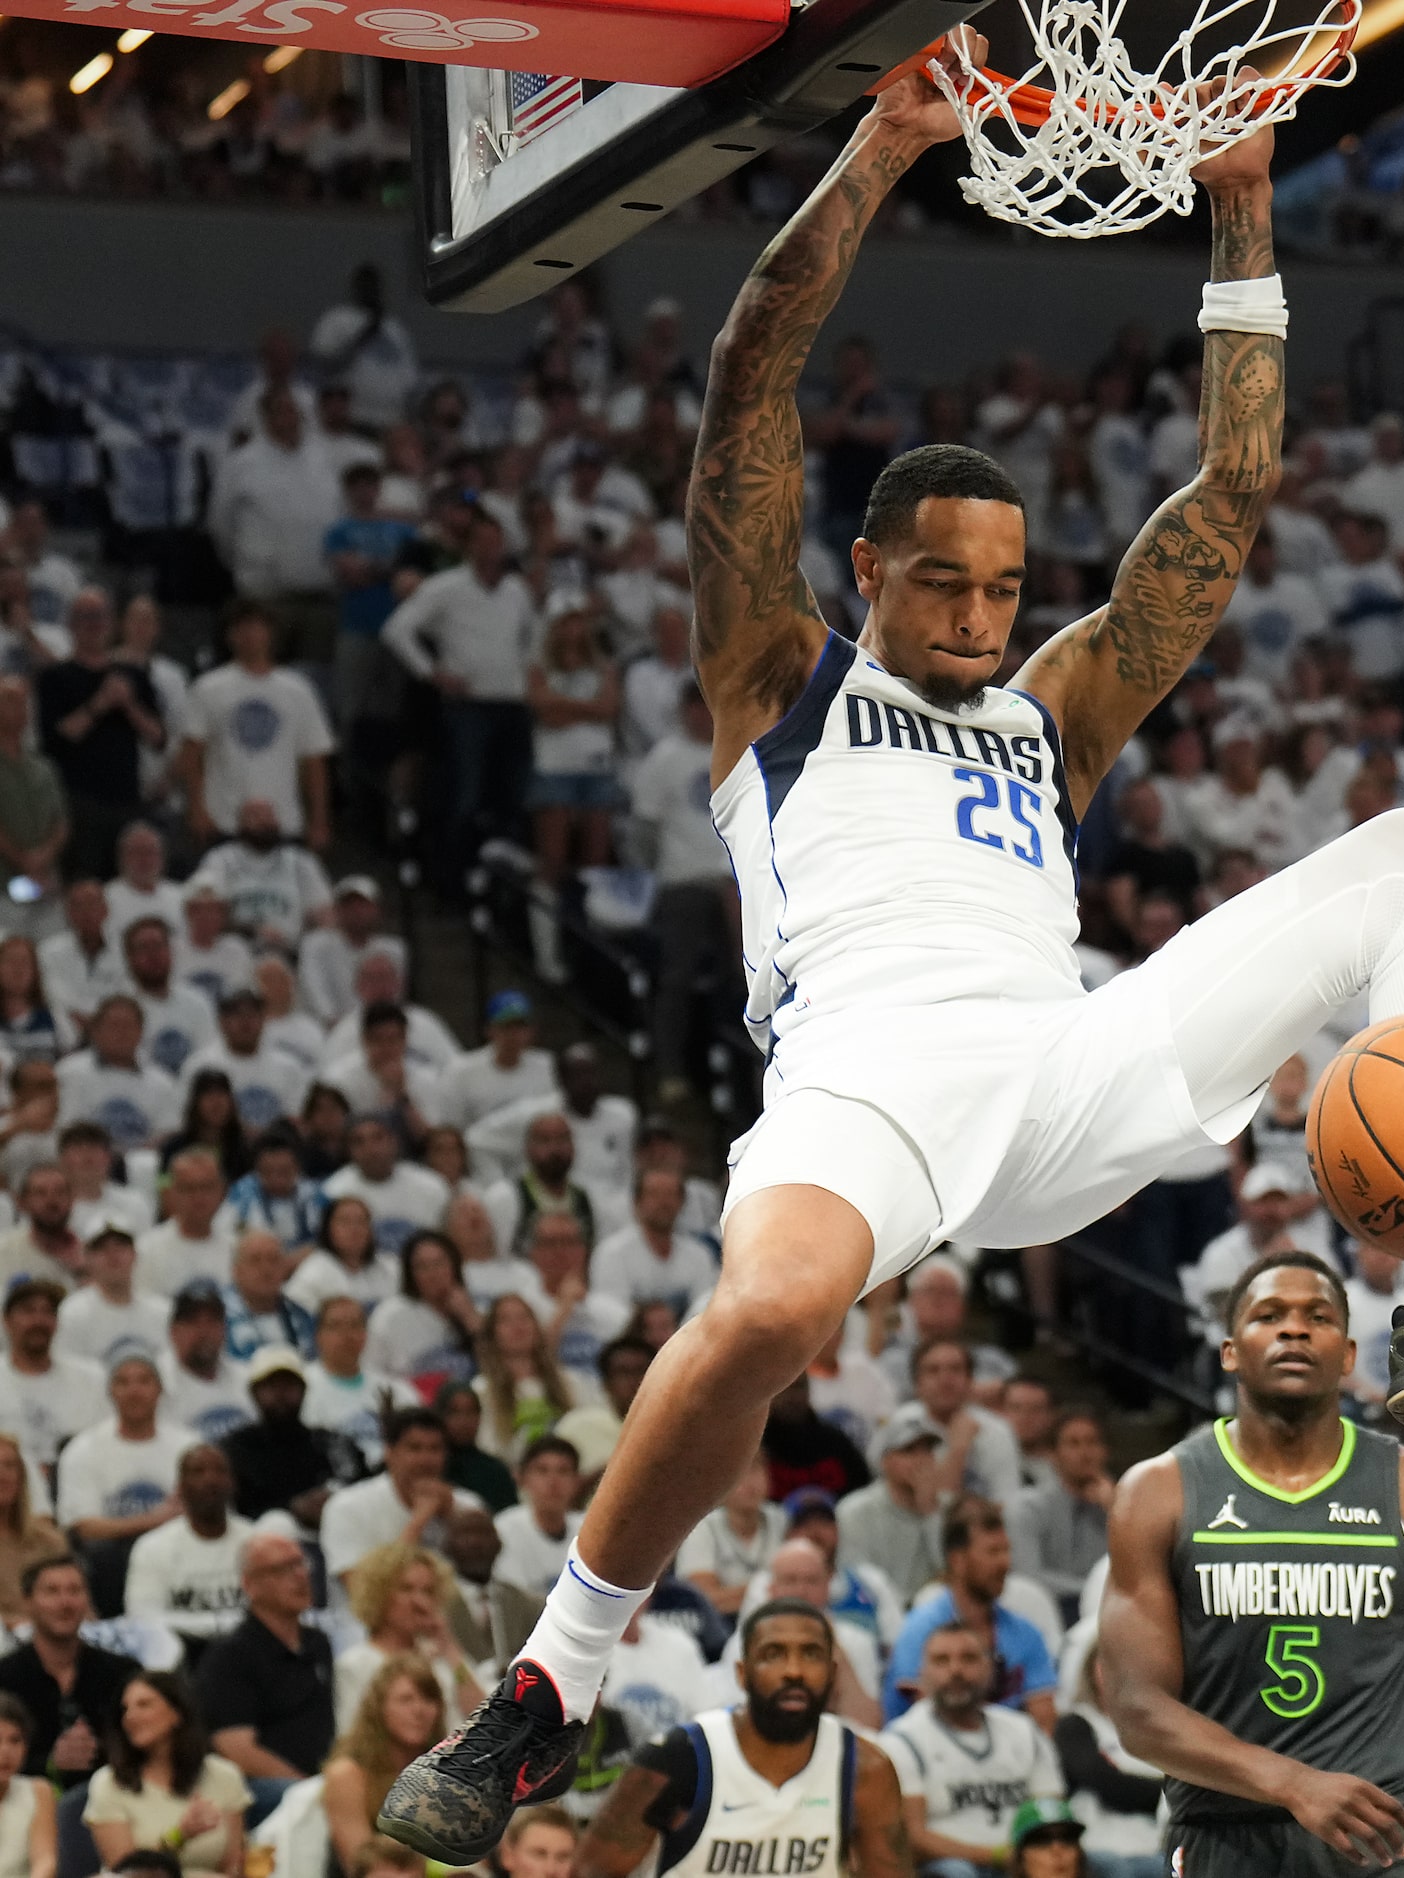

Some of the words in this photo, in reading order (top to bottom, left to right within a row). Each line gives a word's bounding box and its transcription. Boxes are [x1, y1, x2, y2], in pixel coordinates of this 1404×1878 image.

[844, 693, 1043, 784] DALLAS
[952, 767, 1044, 869] 25
[1195, 1562, 1396, 1625] TIMBERWOLVES
[1260, 1625, 1325, 1718] 5
[704, 1836, 830, 1875] DALLAS
